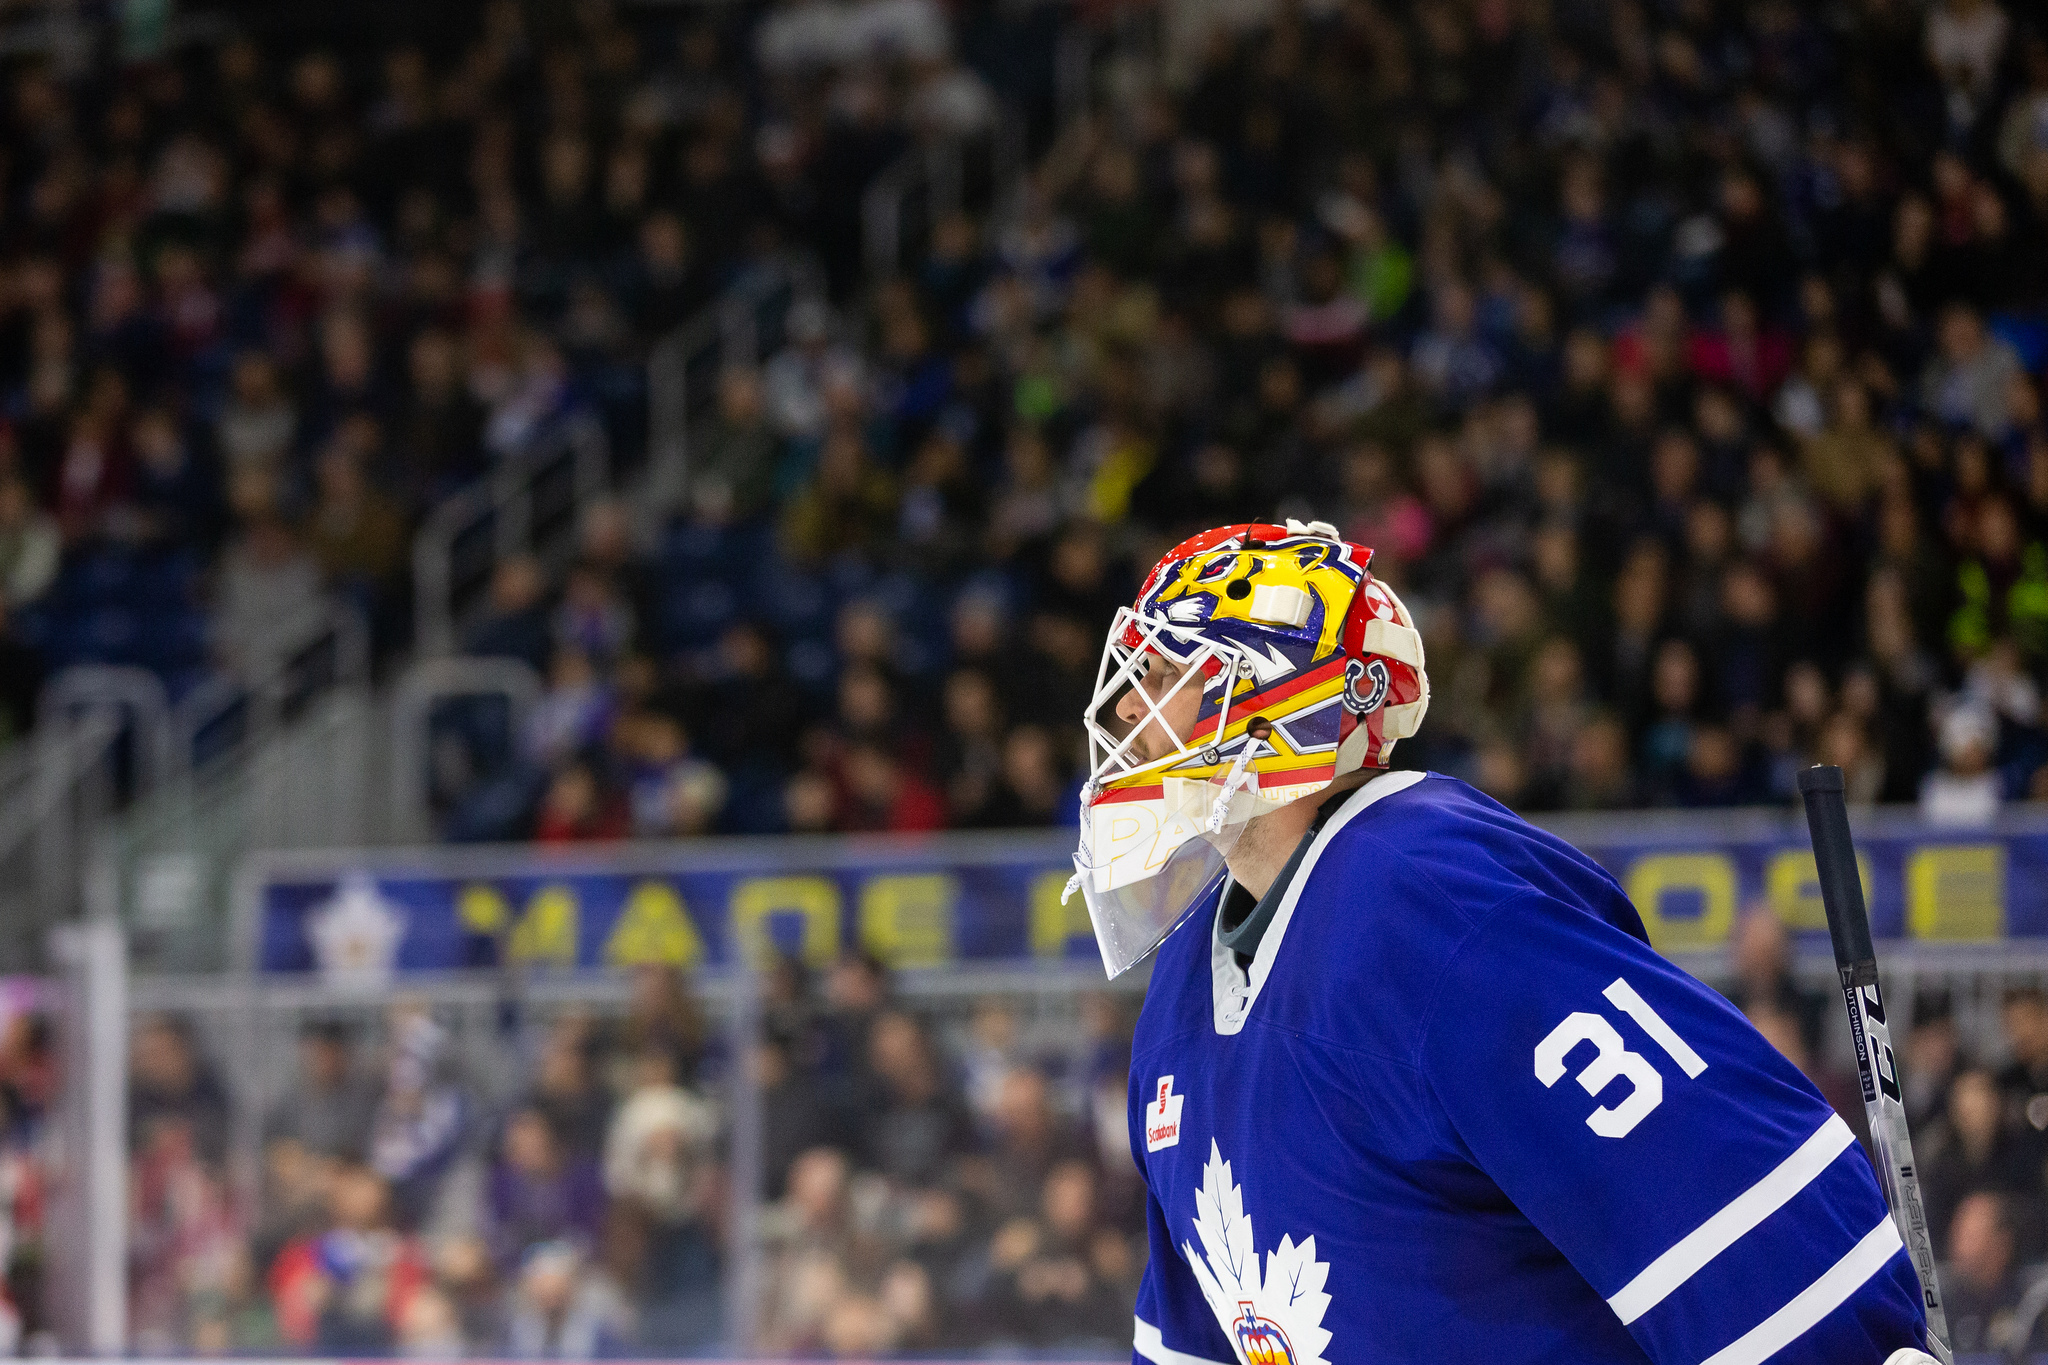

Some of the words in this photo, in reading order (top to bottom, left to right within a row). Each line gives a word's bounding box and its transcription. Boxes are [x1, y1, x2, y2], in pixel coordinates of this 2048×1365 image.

[1534, 977, 1708, 1138] 31
[1148, 1121, 1177, 1143] Scotiabank
[1906, 1184, 1939, 1309] PREMIER
